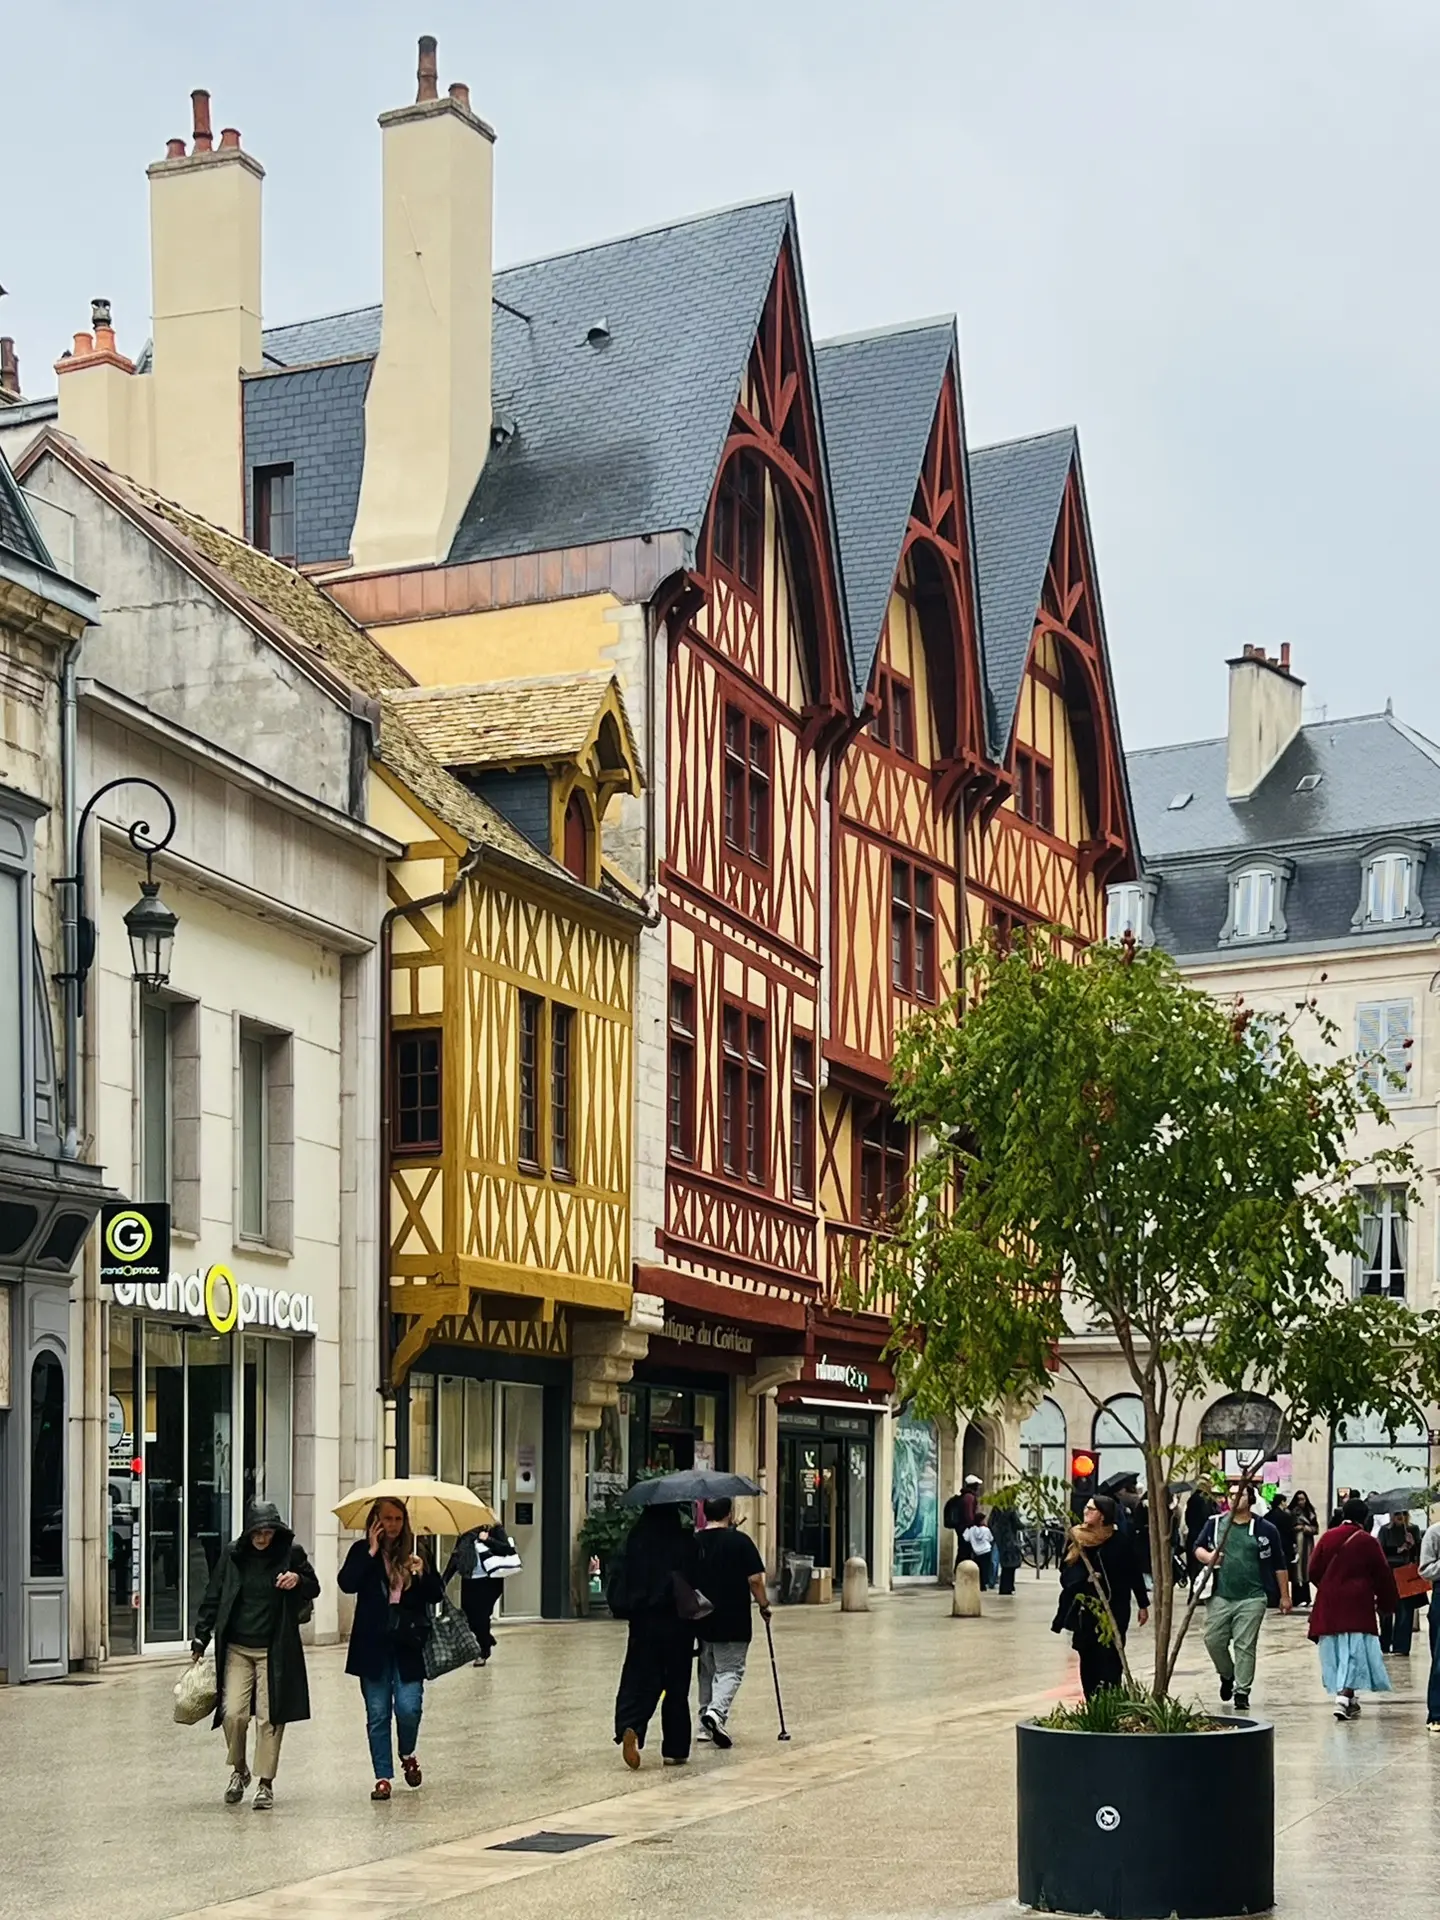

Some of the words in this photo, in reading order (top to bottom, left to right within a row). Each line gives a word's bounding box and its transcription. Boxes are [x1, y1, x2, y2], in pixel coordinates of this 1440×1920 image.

[113, 1218, 145, 1253] G
[662, 1315, 694, 1346] utique
[697, 1320, 711, 1346] du
